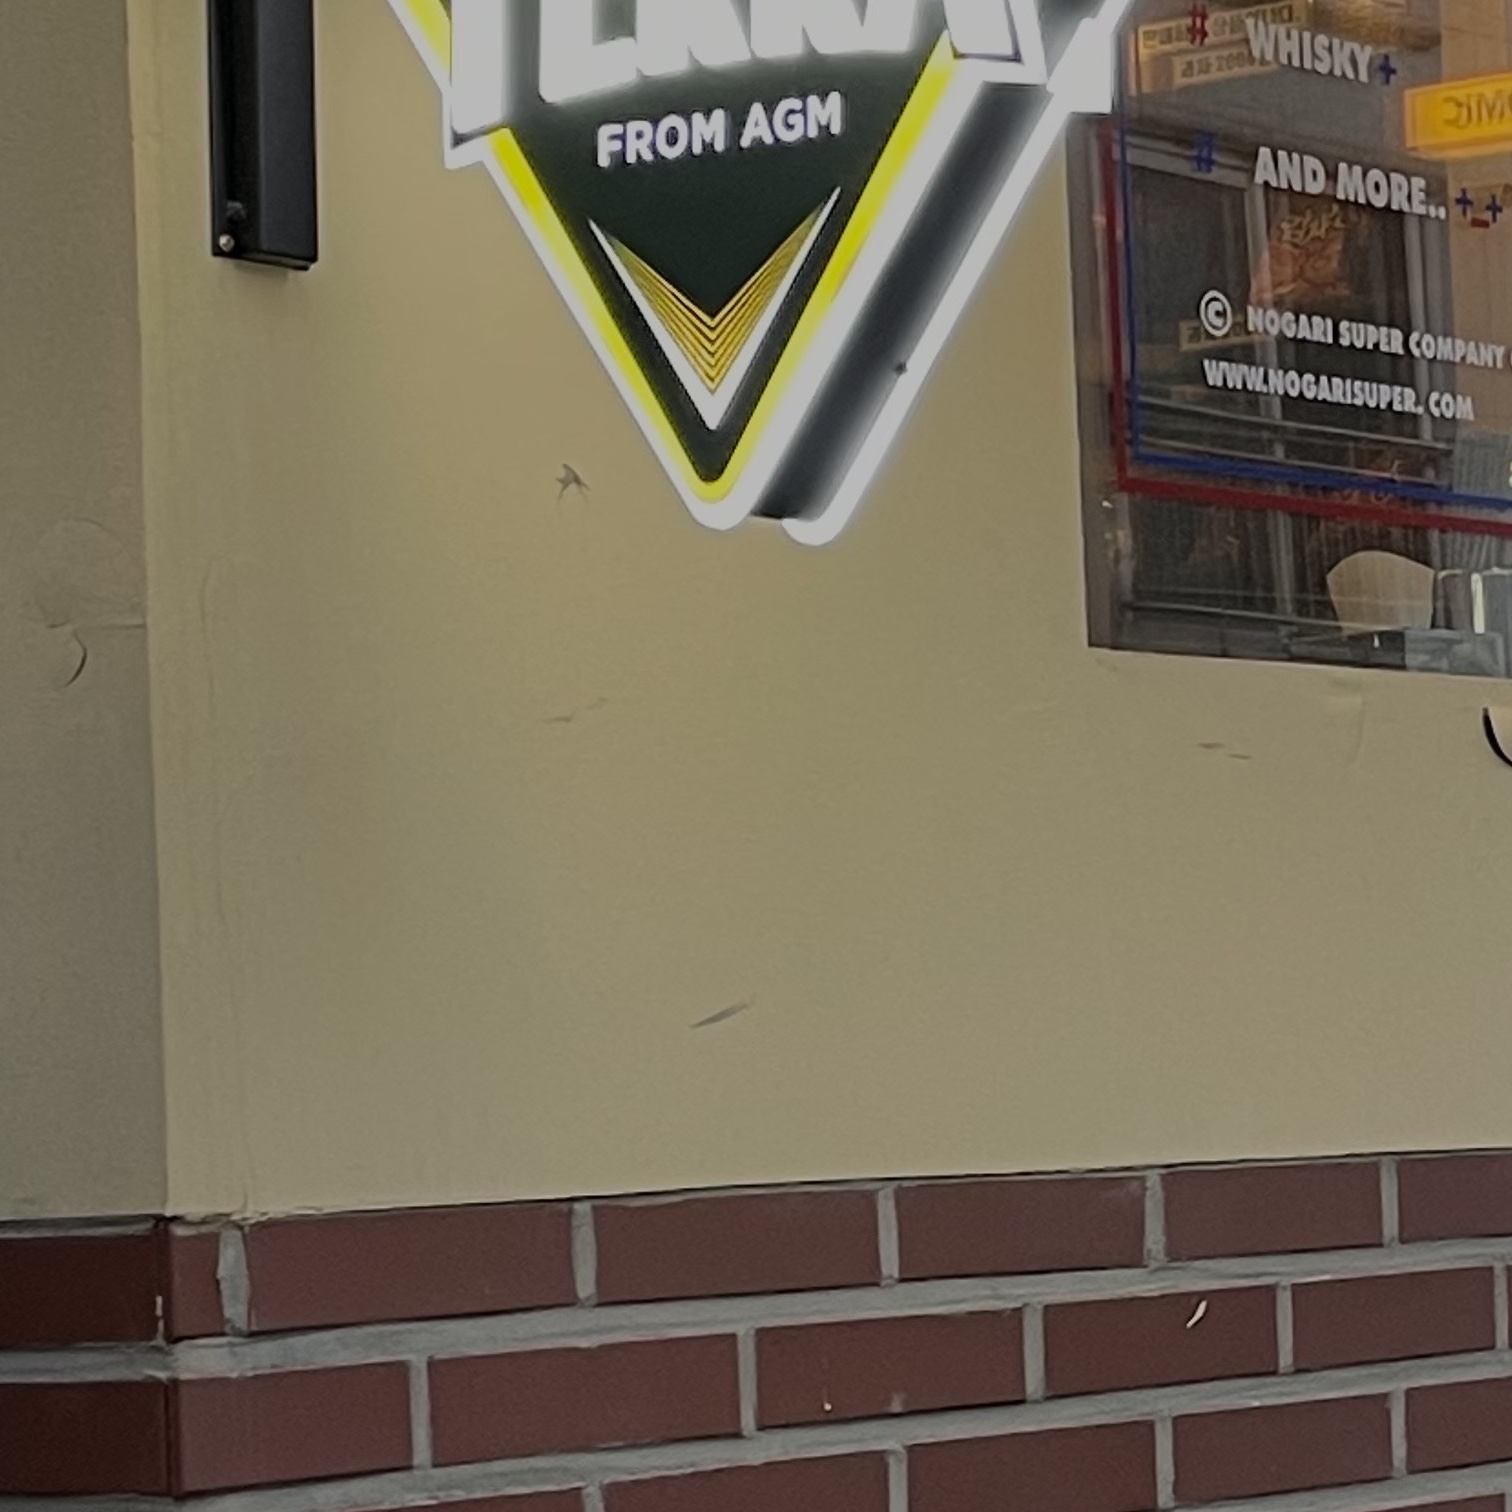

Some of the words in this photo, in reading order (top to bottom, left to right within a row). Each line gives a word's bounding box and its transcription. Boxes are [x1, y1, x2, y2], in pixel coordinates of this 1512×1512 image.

[1246, 17, 1372, 83] WHISKY
[597, 108, 727, 167] FROM
[740, 91, 843, 149] AGM
[1254, 146, 1326, 195] AND
[1247, 305, 1334, 344] NOGARI
[1338, 320, 1404, 355] SUPER
[1408, 330, 1505, 369] COMPANY
